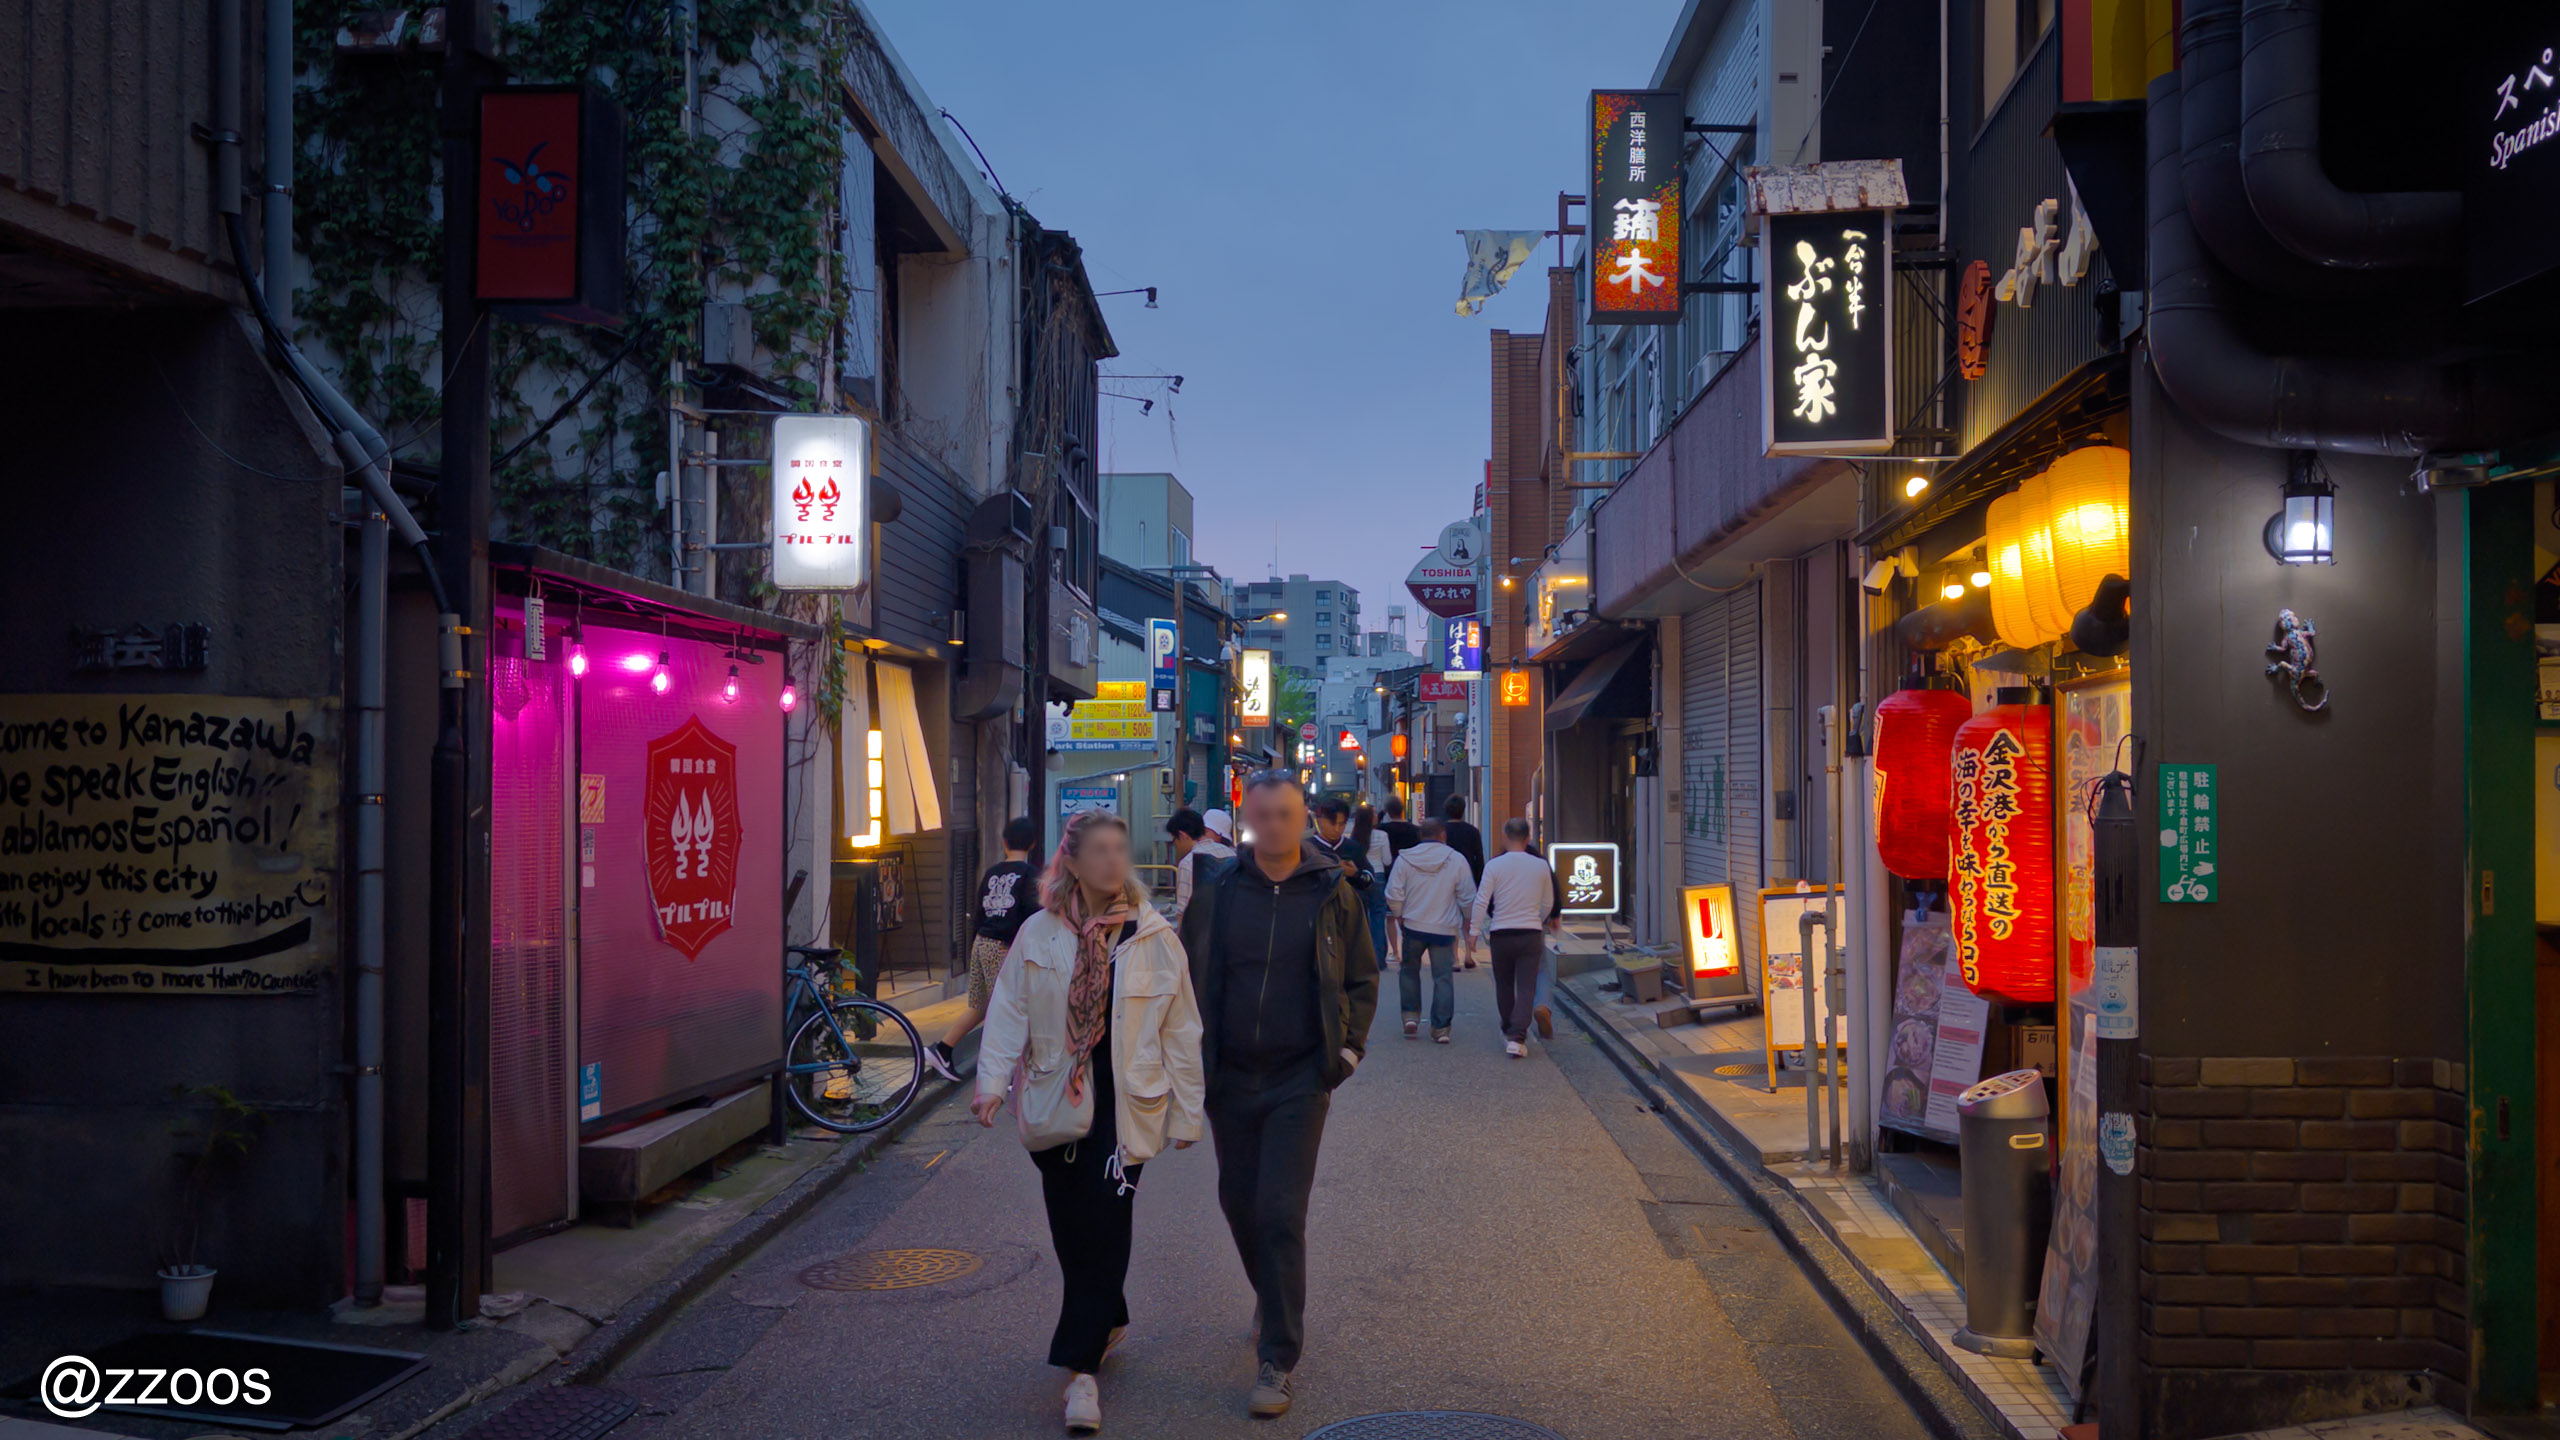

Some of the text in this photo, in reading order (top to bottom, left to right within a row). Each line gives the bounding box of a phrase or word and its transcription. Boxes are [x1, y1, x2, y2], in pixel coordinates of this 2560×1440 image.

[1628, 111, 1647, 182] 西洋膳所
[1841, 229, 1867, 330] 一合半
[1787, 240, 1837, 423] ぶん家
[779, 533, 853, 544] プルプル
[1421, 568, 1472, 577] TOSHIBA
[1421, 587, 1471, 599] すみれや
[1075, 741, 1115, 750] Station
[2193, 771, 2210, 854] 駐輪禁止
[1983, 731, 2023, 937] 金沢港から直送の
[27, 867, 90, 907] enjoy
[97, 863, 147, 893] this
[154, 865, 217, 899] city
[1568, 889, 1603, 903] ランプ
[30, 900, 105, 940] locals
[112, 910, 132, 938] if
[138, 907, 192, 932] come
[196, 906, 215, 924] to
[255, 894, 297, 925] bar
[25, 970, 40, 987] I
[50, 967, 87, 989] have
[91, 968, 129, 987] been
[132, 971, 154, 987] to
[162, 972, 205, 988] more
[2027, 1032, 2056, 1044] 石川
